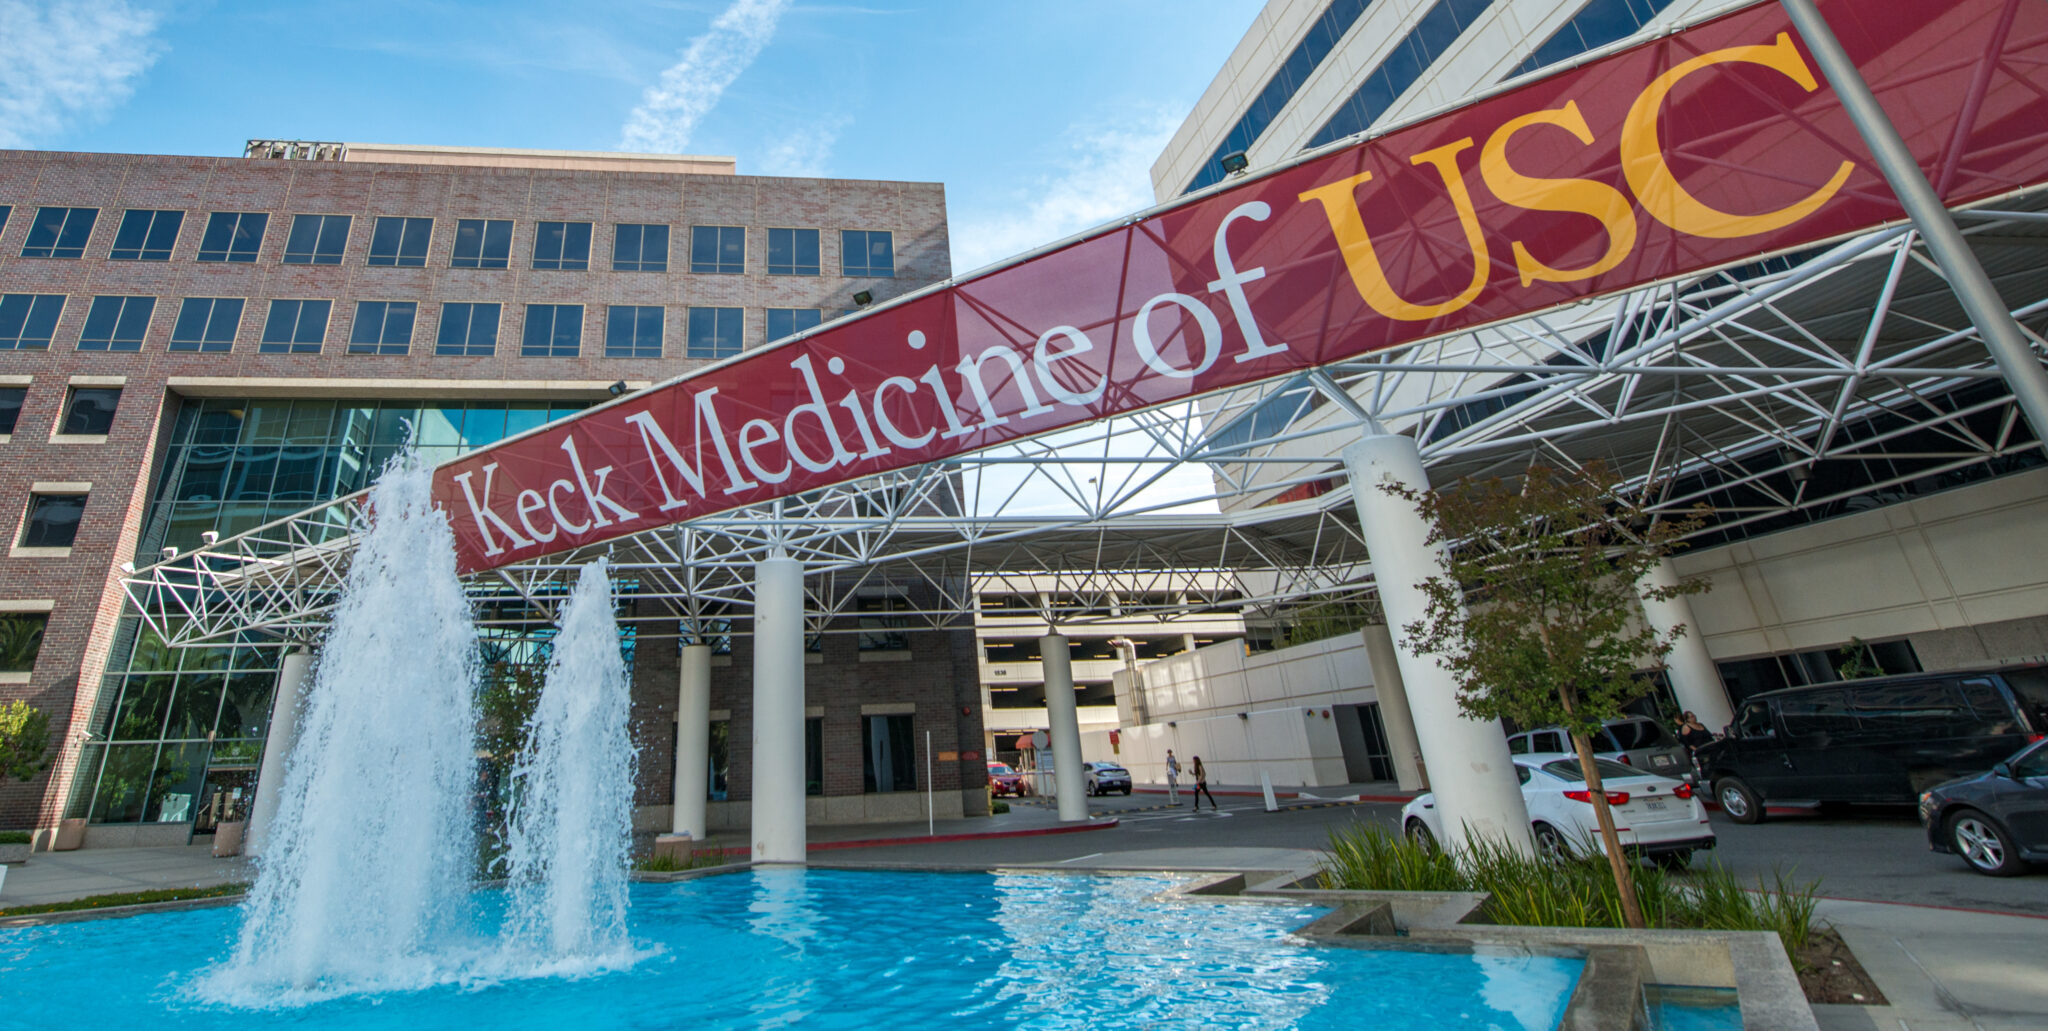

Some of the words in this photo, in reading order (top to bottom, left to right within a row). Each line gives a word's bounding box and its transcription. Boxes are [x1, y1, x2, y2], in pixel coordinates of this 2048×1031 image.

[453, 435, 639, 557] Keck
[624, 324, 1108, 512] Medicine
[1133, 201, 1289, 378] of
[1298, 32, 1856, 322] USC
